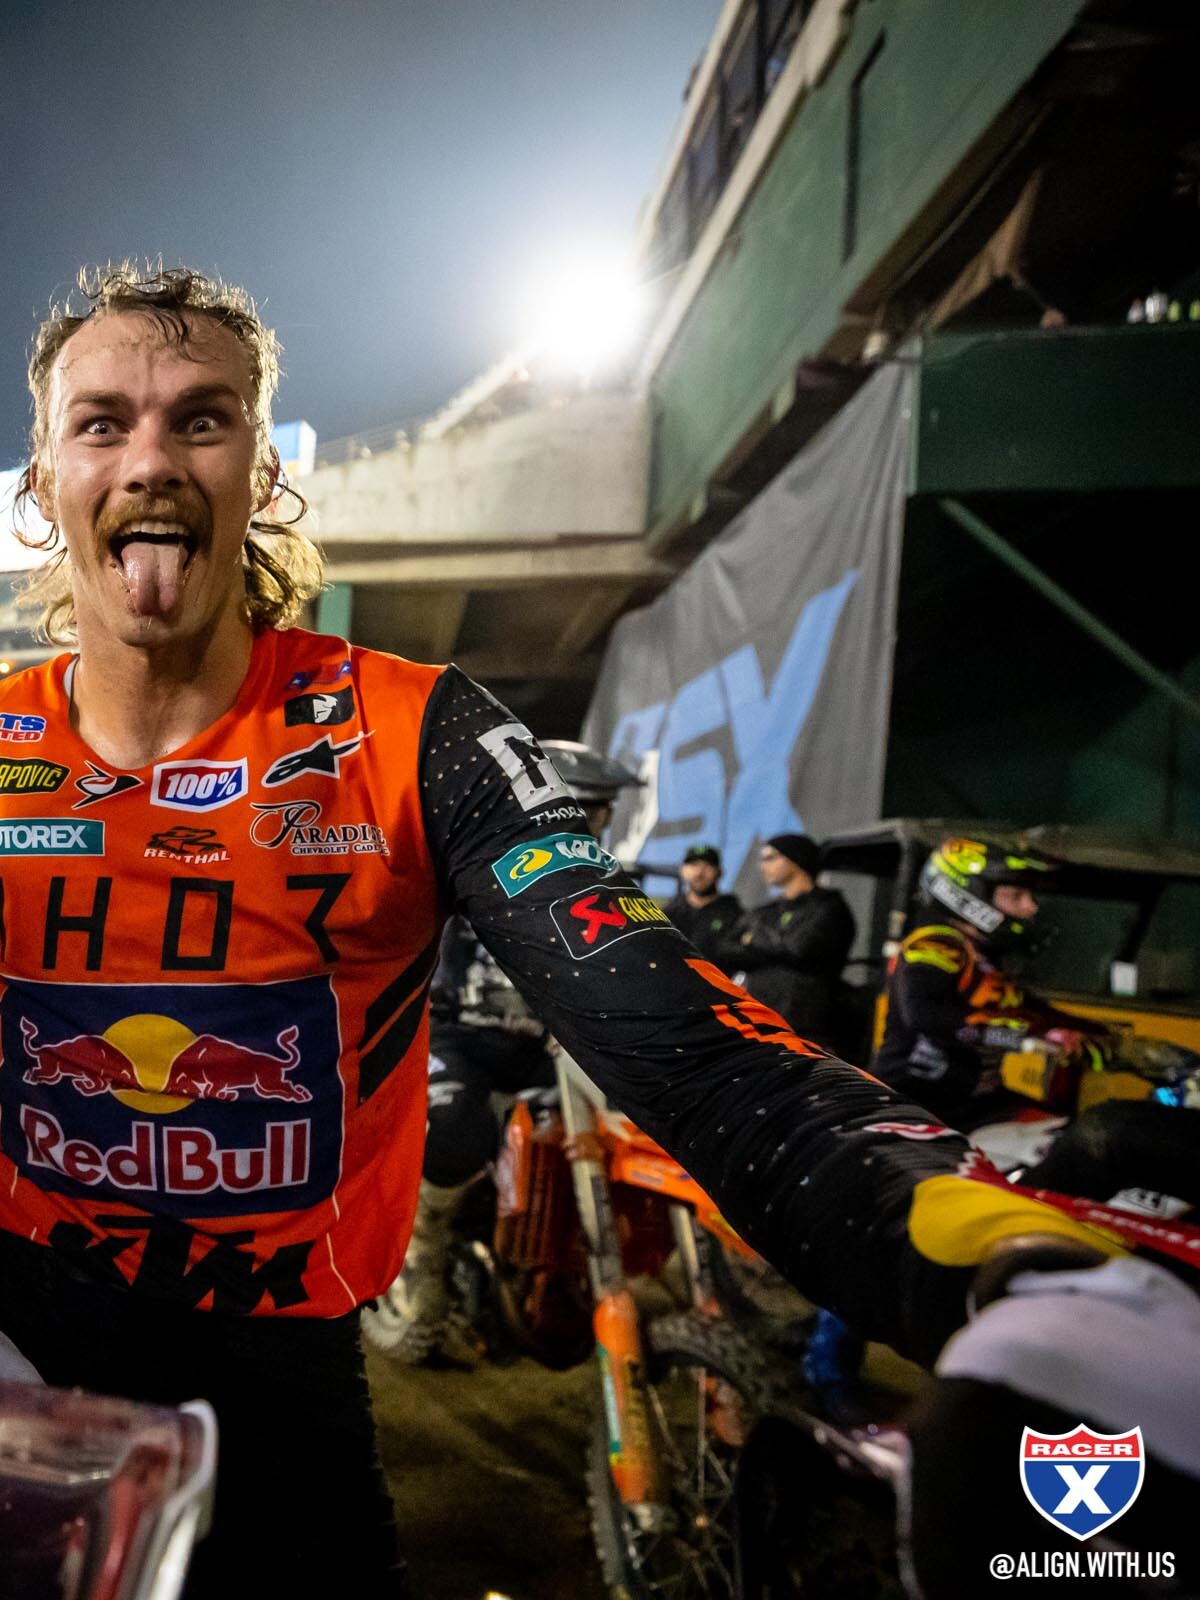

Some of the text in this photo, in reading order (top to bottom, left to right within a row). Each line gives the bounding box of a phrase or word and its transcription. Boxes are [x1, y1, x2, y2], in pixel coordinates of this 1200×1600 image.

[165, 769, 238, 800] 100%
[143, 848, 231, 864] RENTHAL
[291, 846, 348, 855] CHEVROLET
[19, 1104, 311, 1195] Red Bull
